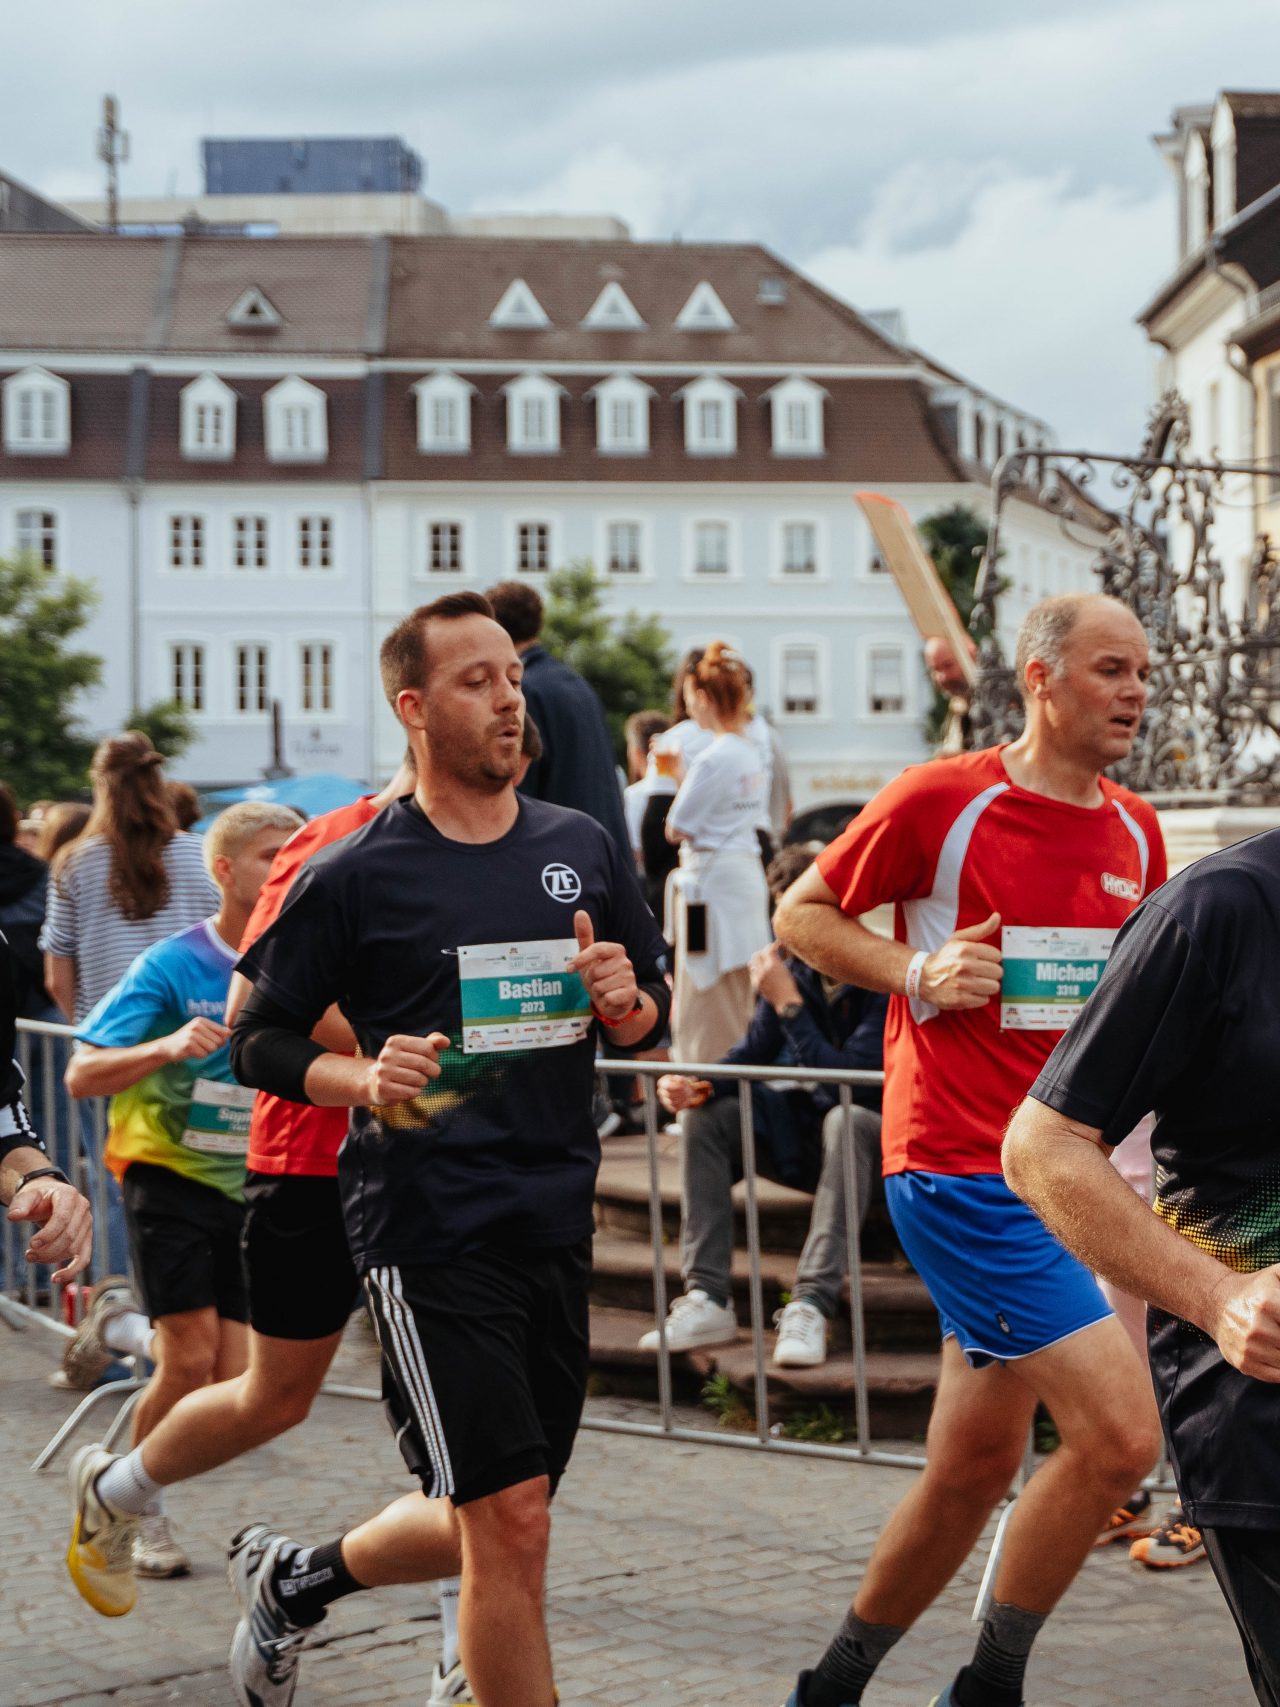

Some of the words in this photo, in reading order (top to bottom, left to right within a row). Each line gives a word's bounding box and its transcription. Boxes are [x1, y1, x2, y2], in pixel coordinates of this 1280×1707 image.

[542, 866, 580, 899] ZF
[1035, 962, 1099, 982] Michael
[498, 978, 563, 1000] Bastian
[520, 1001, 546, 1014] 2073
